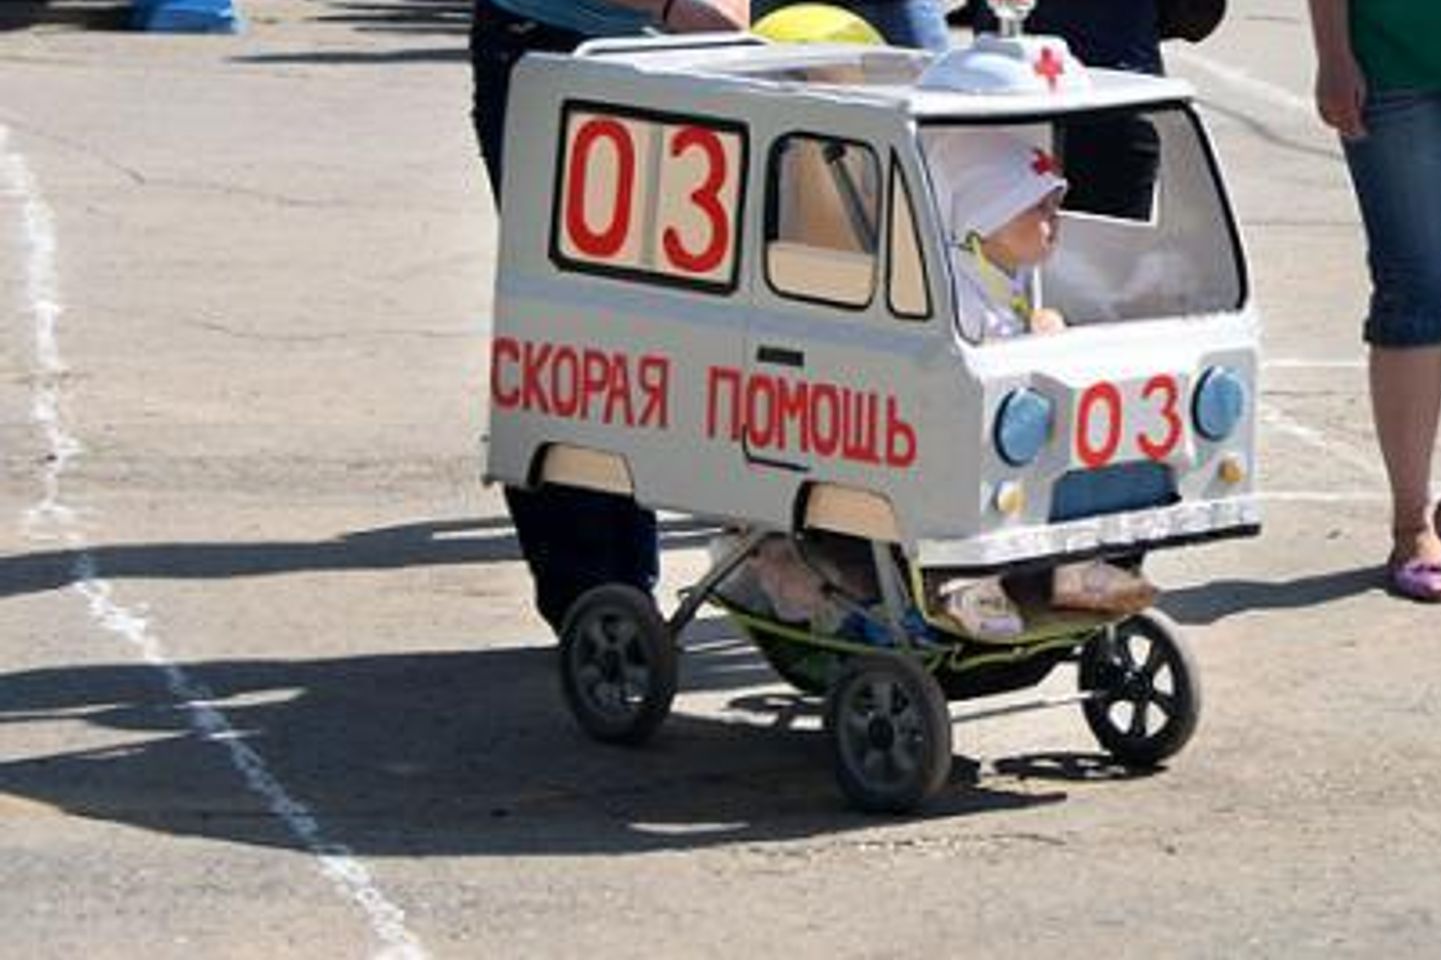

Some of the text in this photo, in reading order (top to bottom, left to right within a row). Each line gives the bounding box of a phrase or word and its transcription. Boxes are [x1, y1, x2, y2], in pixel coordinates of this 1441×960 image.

[564, 118, 732, 277] 03
[491, 336, 920, 470] СКОРАЯ ПОМОЩЬ
[1073, 373, 1186, 470] 03
